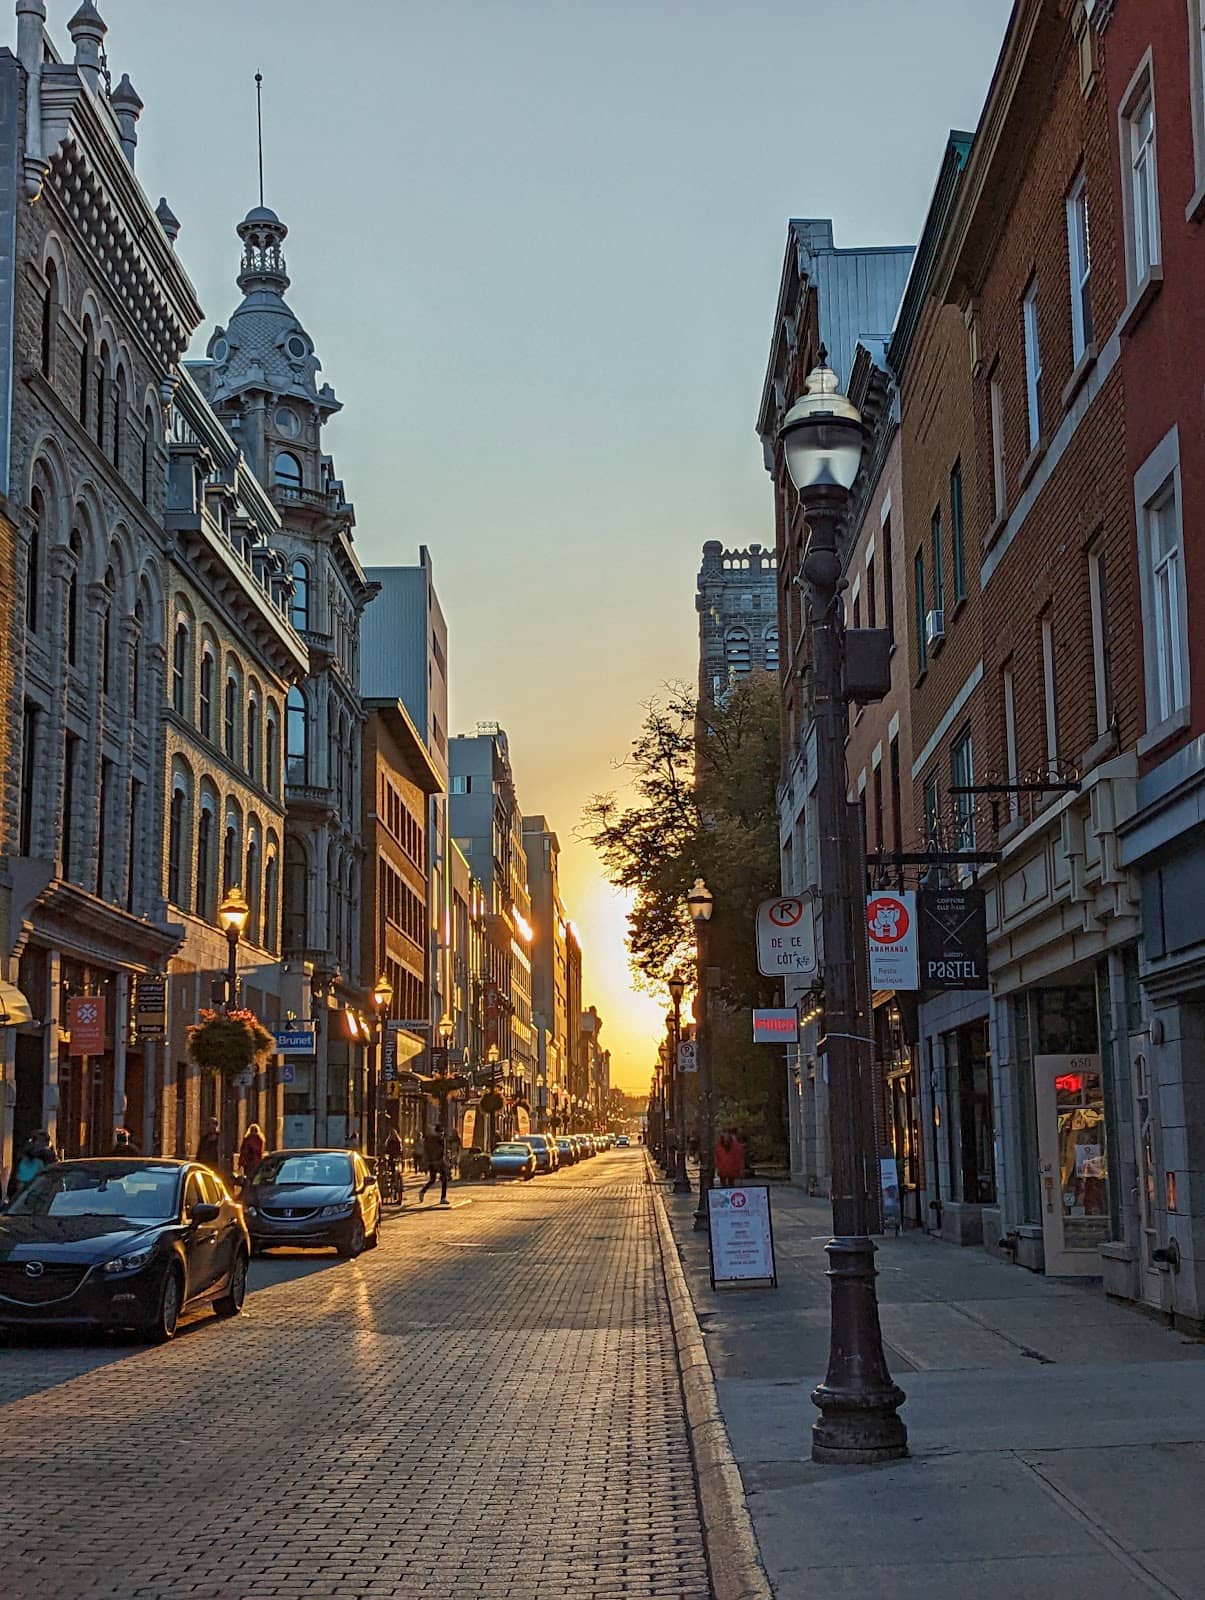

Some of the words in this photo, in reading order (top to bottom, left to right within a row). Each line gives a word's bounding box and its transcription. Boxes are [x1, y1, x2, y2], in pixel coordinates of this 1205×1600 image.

[771, 938, 783, 949] DE
[791, 936, 803, 947] CE
[278, 1035, 312, 1045] Brunet
[1070, 1058, 1092, 1069] 650
